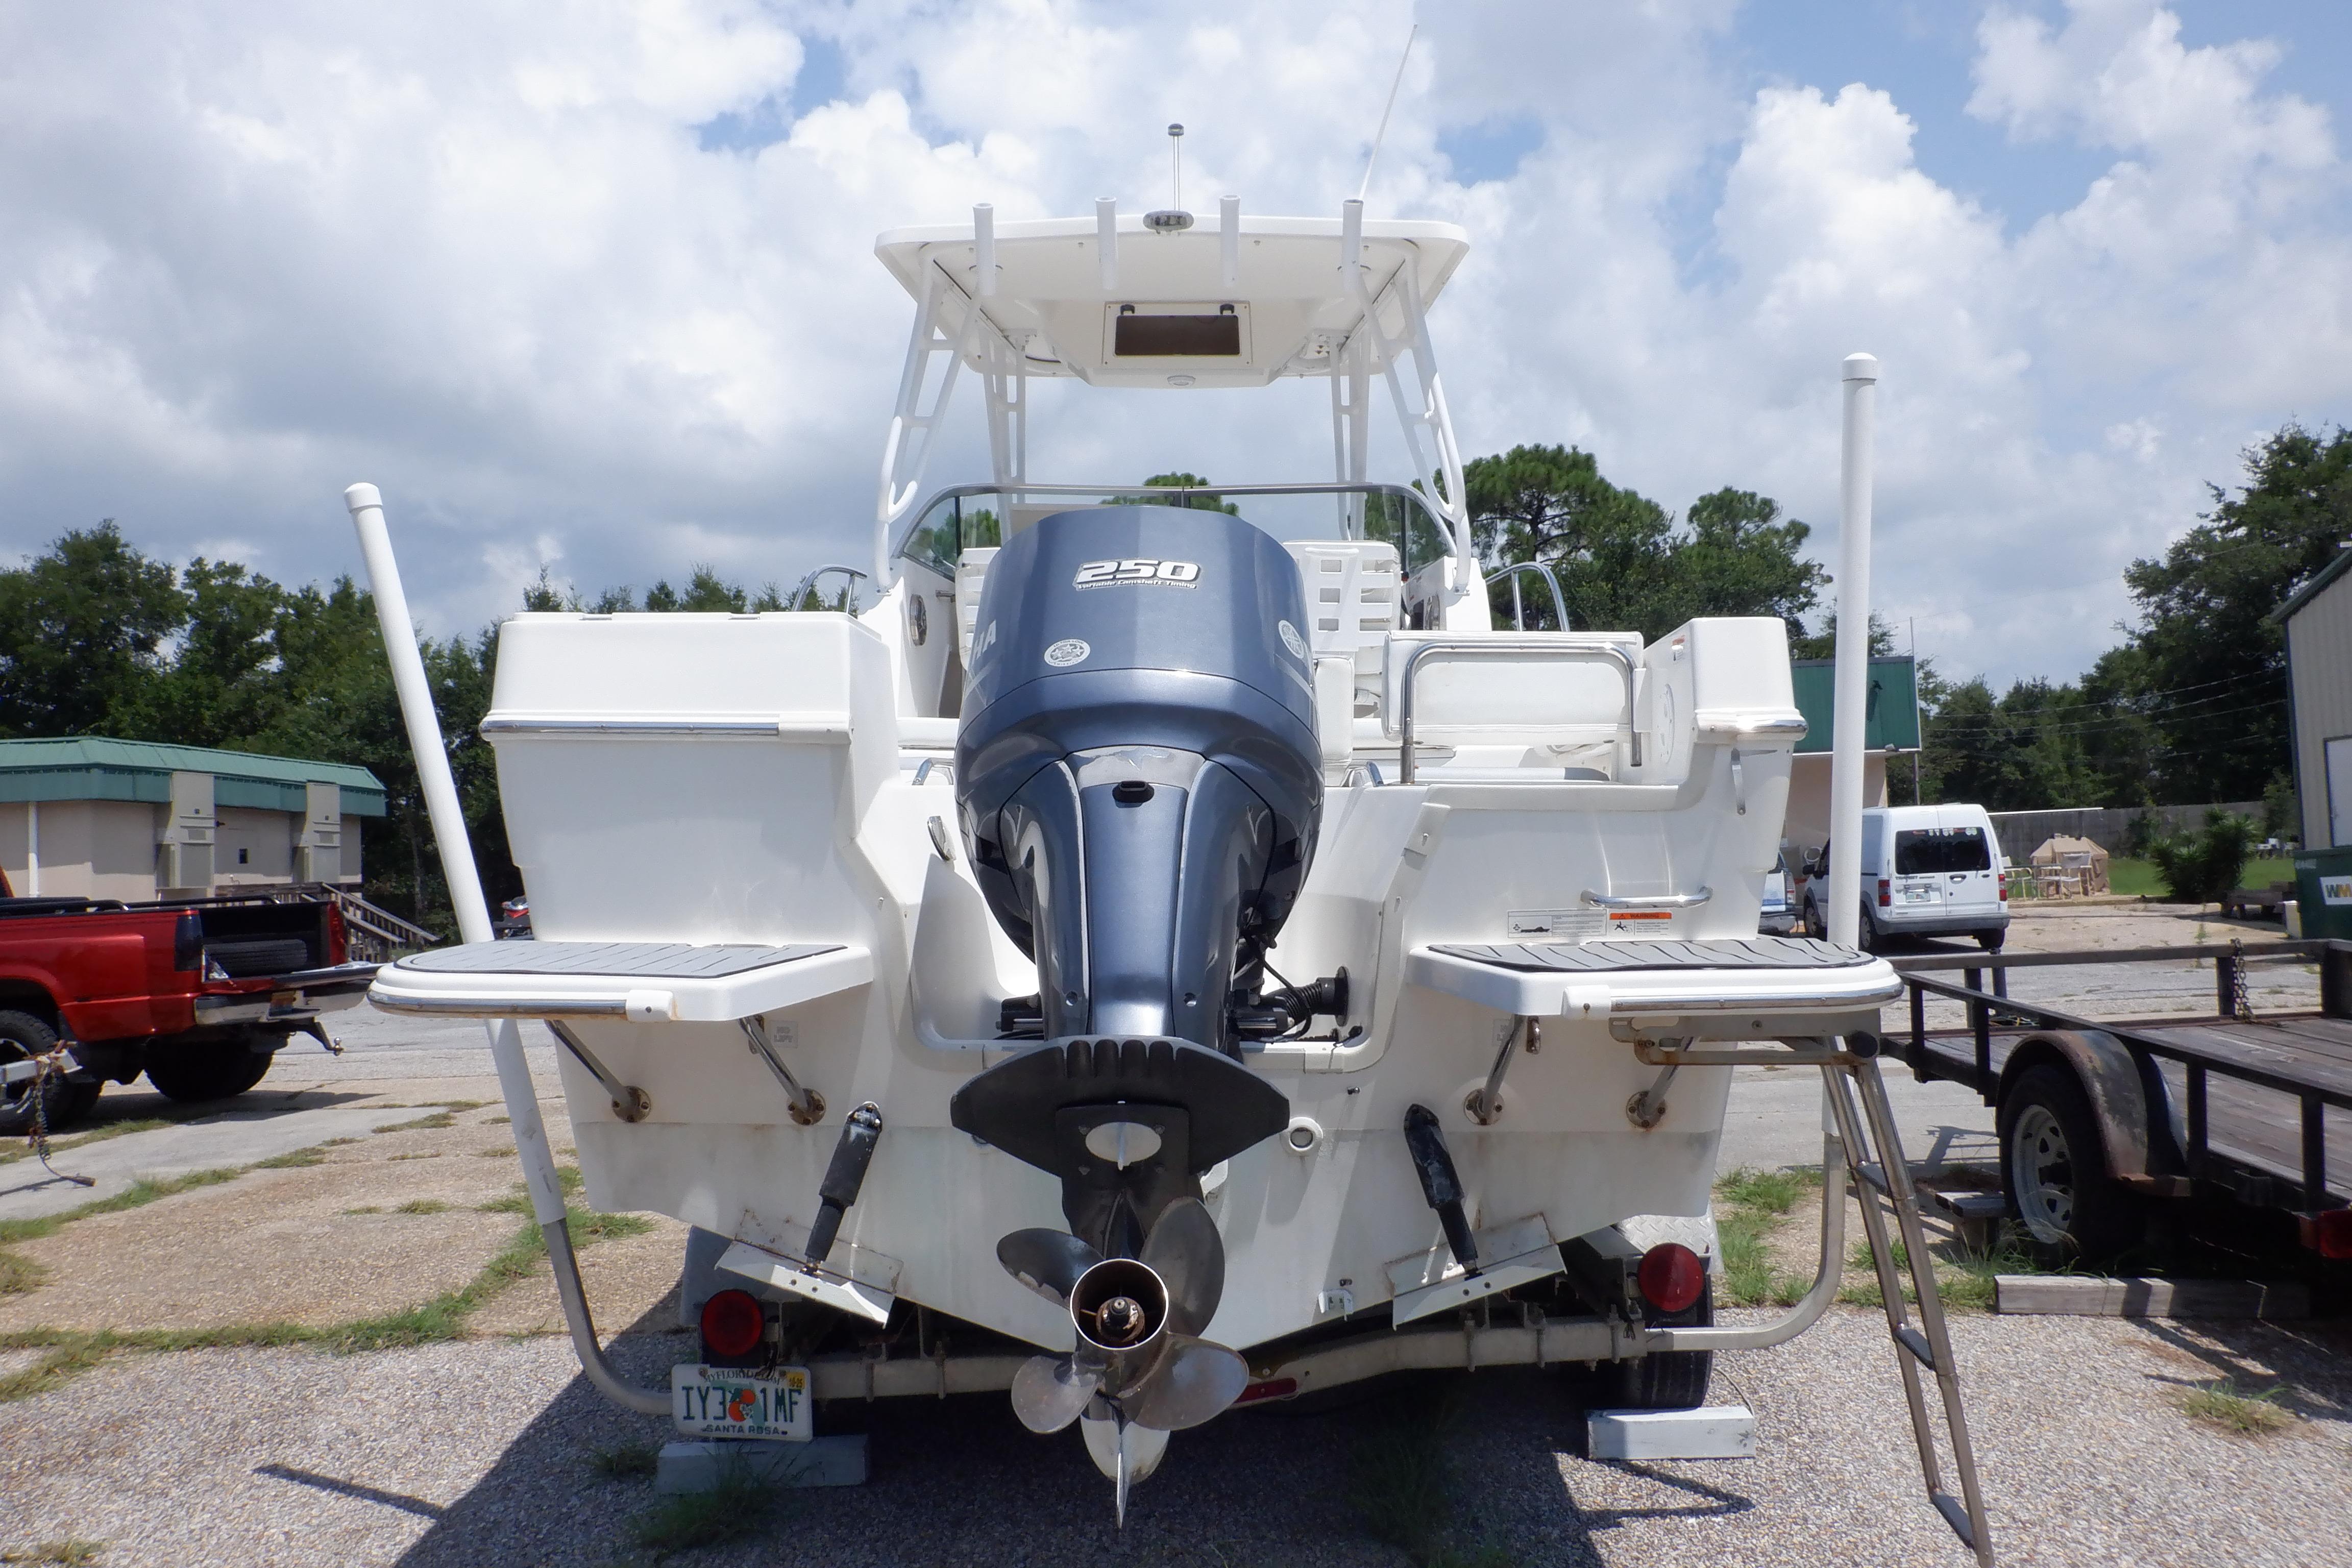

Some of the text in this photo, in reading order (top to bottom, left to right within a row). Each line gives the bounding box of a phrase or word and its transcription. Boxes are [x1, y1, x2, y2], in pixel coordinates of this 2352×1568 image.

[1076, 559, 1199, 583] 250
[1165, 580, 1197, 589] Timing
[748, 1425, 779, 1435] ROSA
